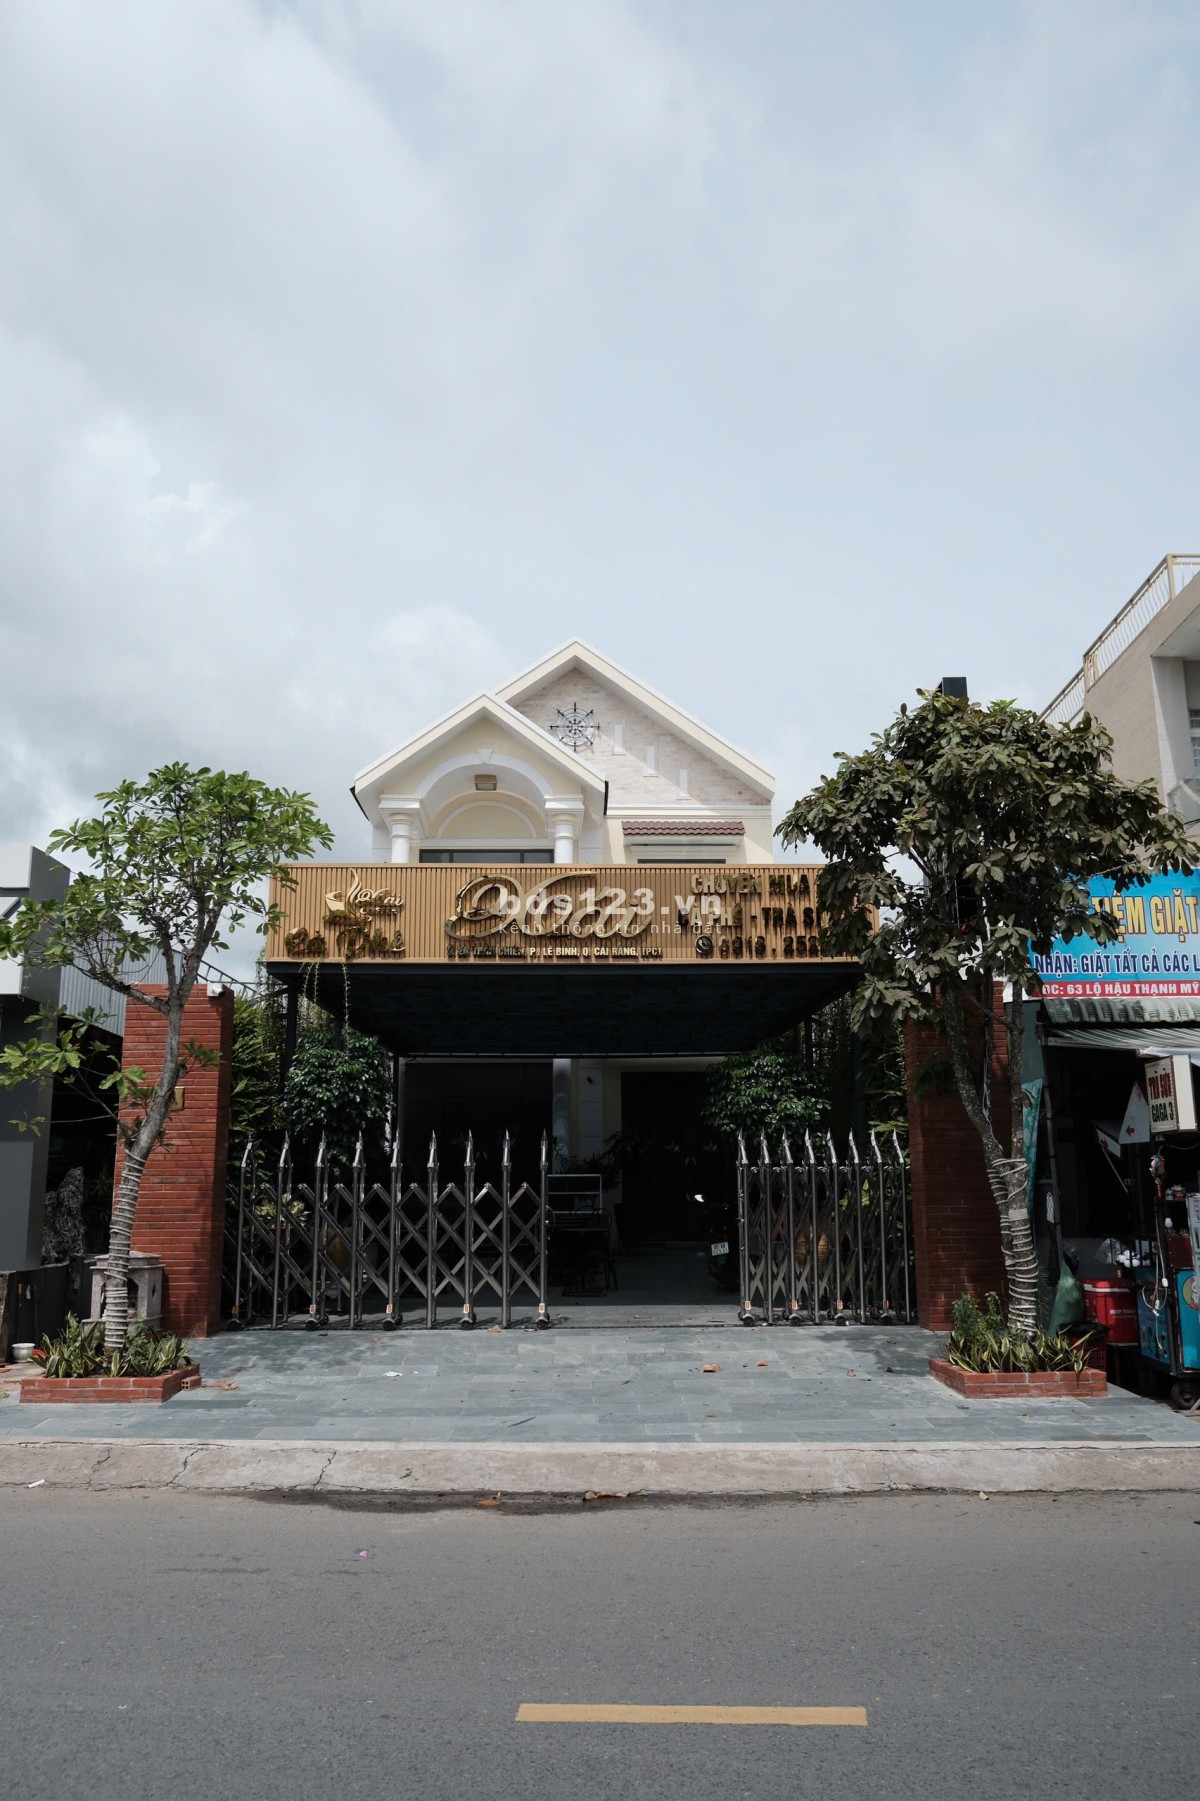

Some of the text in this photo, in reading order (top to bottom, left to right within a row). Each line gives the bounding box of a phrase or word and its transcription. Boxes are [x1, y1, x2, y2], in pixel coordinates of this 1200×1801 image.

[1150, 888, 1198, 942] GIẶT
[1080, 951, 1111, 977] GIẶT
[1113, 948, 1138, 973] TẤT
[1141, 948, 1160, 973] CẢ
[1162, 950, 1190, 973] CÁC
[1066, 984, 1083, 995] 63
[1133, 983, 1178, 997] THẠNH
